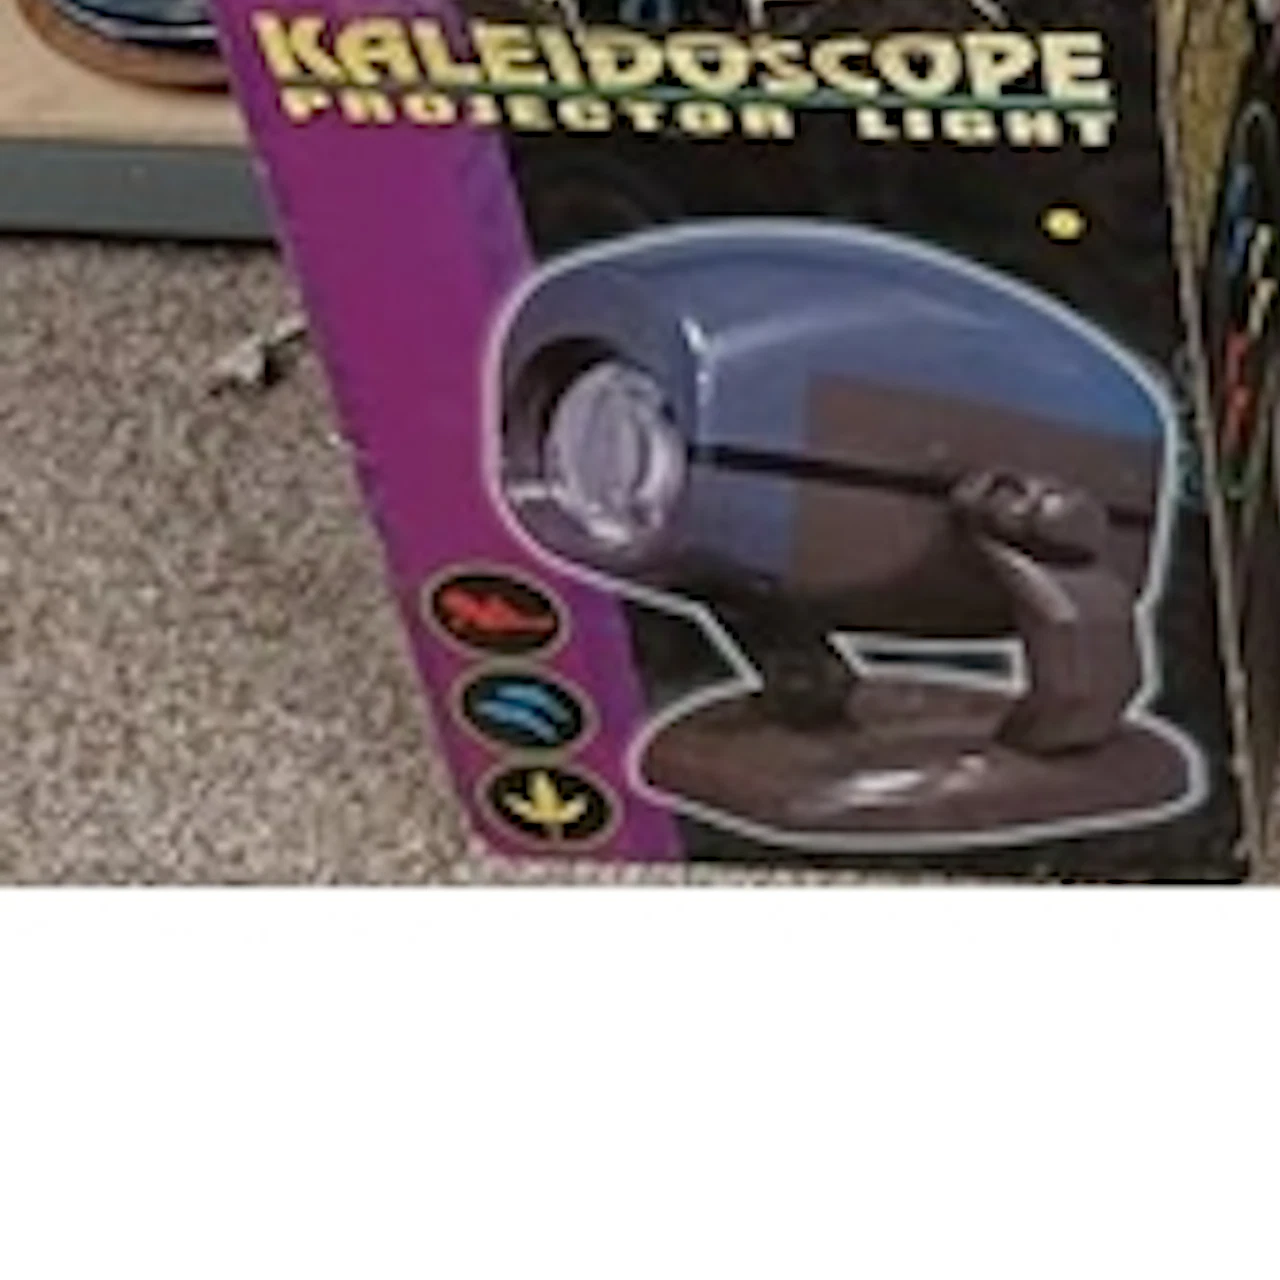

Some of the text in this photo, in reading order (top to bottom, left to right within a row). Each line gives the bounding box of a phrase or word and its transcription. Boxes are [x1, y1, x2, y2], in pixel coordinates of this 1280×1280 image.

[252, 12, 1113, 103] KALEIDOSCOPE
[279, 86, 1118, 149] PROJECTOR LIGHT
